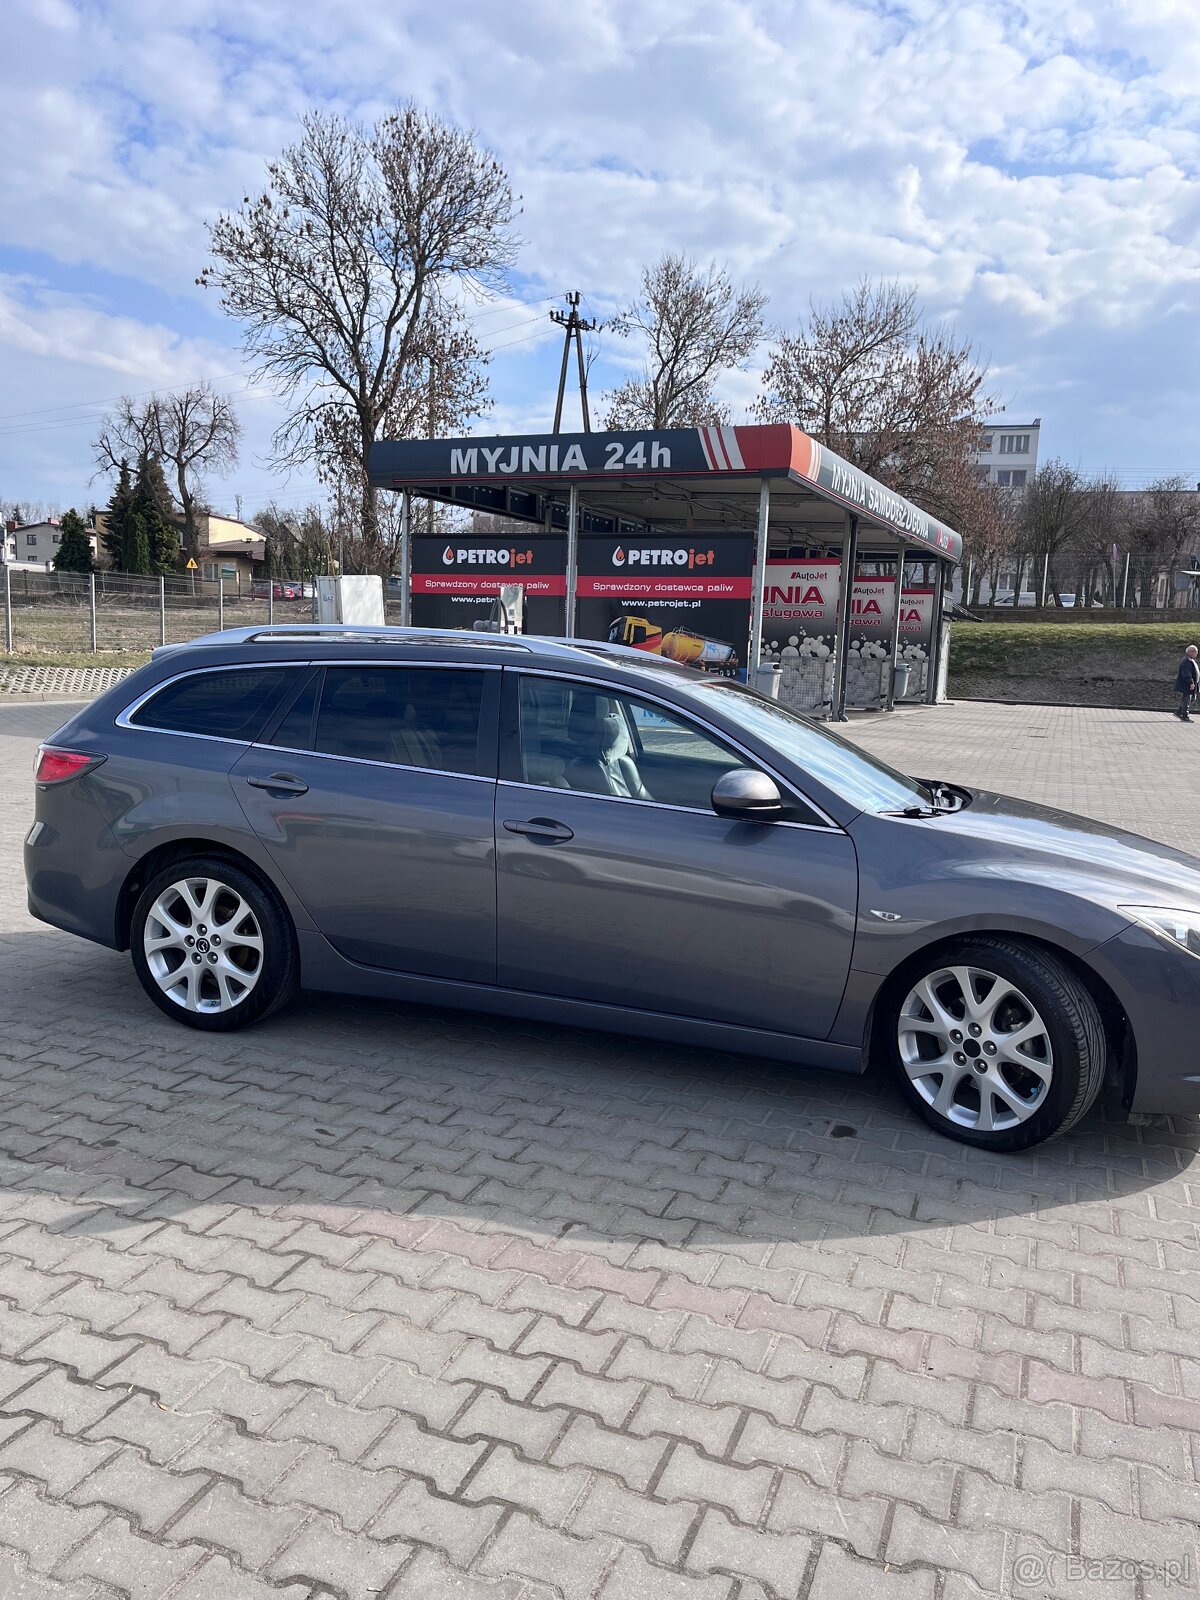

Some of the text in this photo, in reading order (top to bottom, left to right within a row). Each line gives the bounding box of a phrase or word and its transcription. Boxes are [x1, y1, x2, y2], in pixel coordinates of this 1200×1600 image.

[450, 440, 671, 475] MYJNIA 24h
[831, 463, 866, 506] MYJNIA
[456, 548, 534, 568] PETROjet
[627, 548, 715, 569] PETROjet
[795, 571, 828, 582] AutoJet
[425, 579, 478, 589] Sprawdzony
[526, 581, 550, 590] paliw
[593, 582, 734, 592] Sprawdzony dostawca paliw
[451, 596, 496, 604] www.petr
[753, 585, 825, 604] JNIA
[621, 599, 701, 609] www.petrojet.pl
